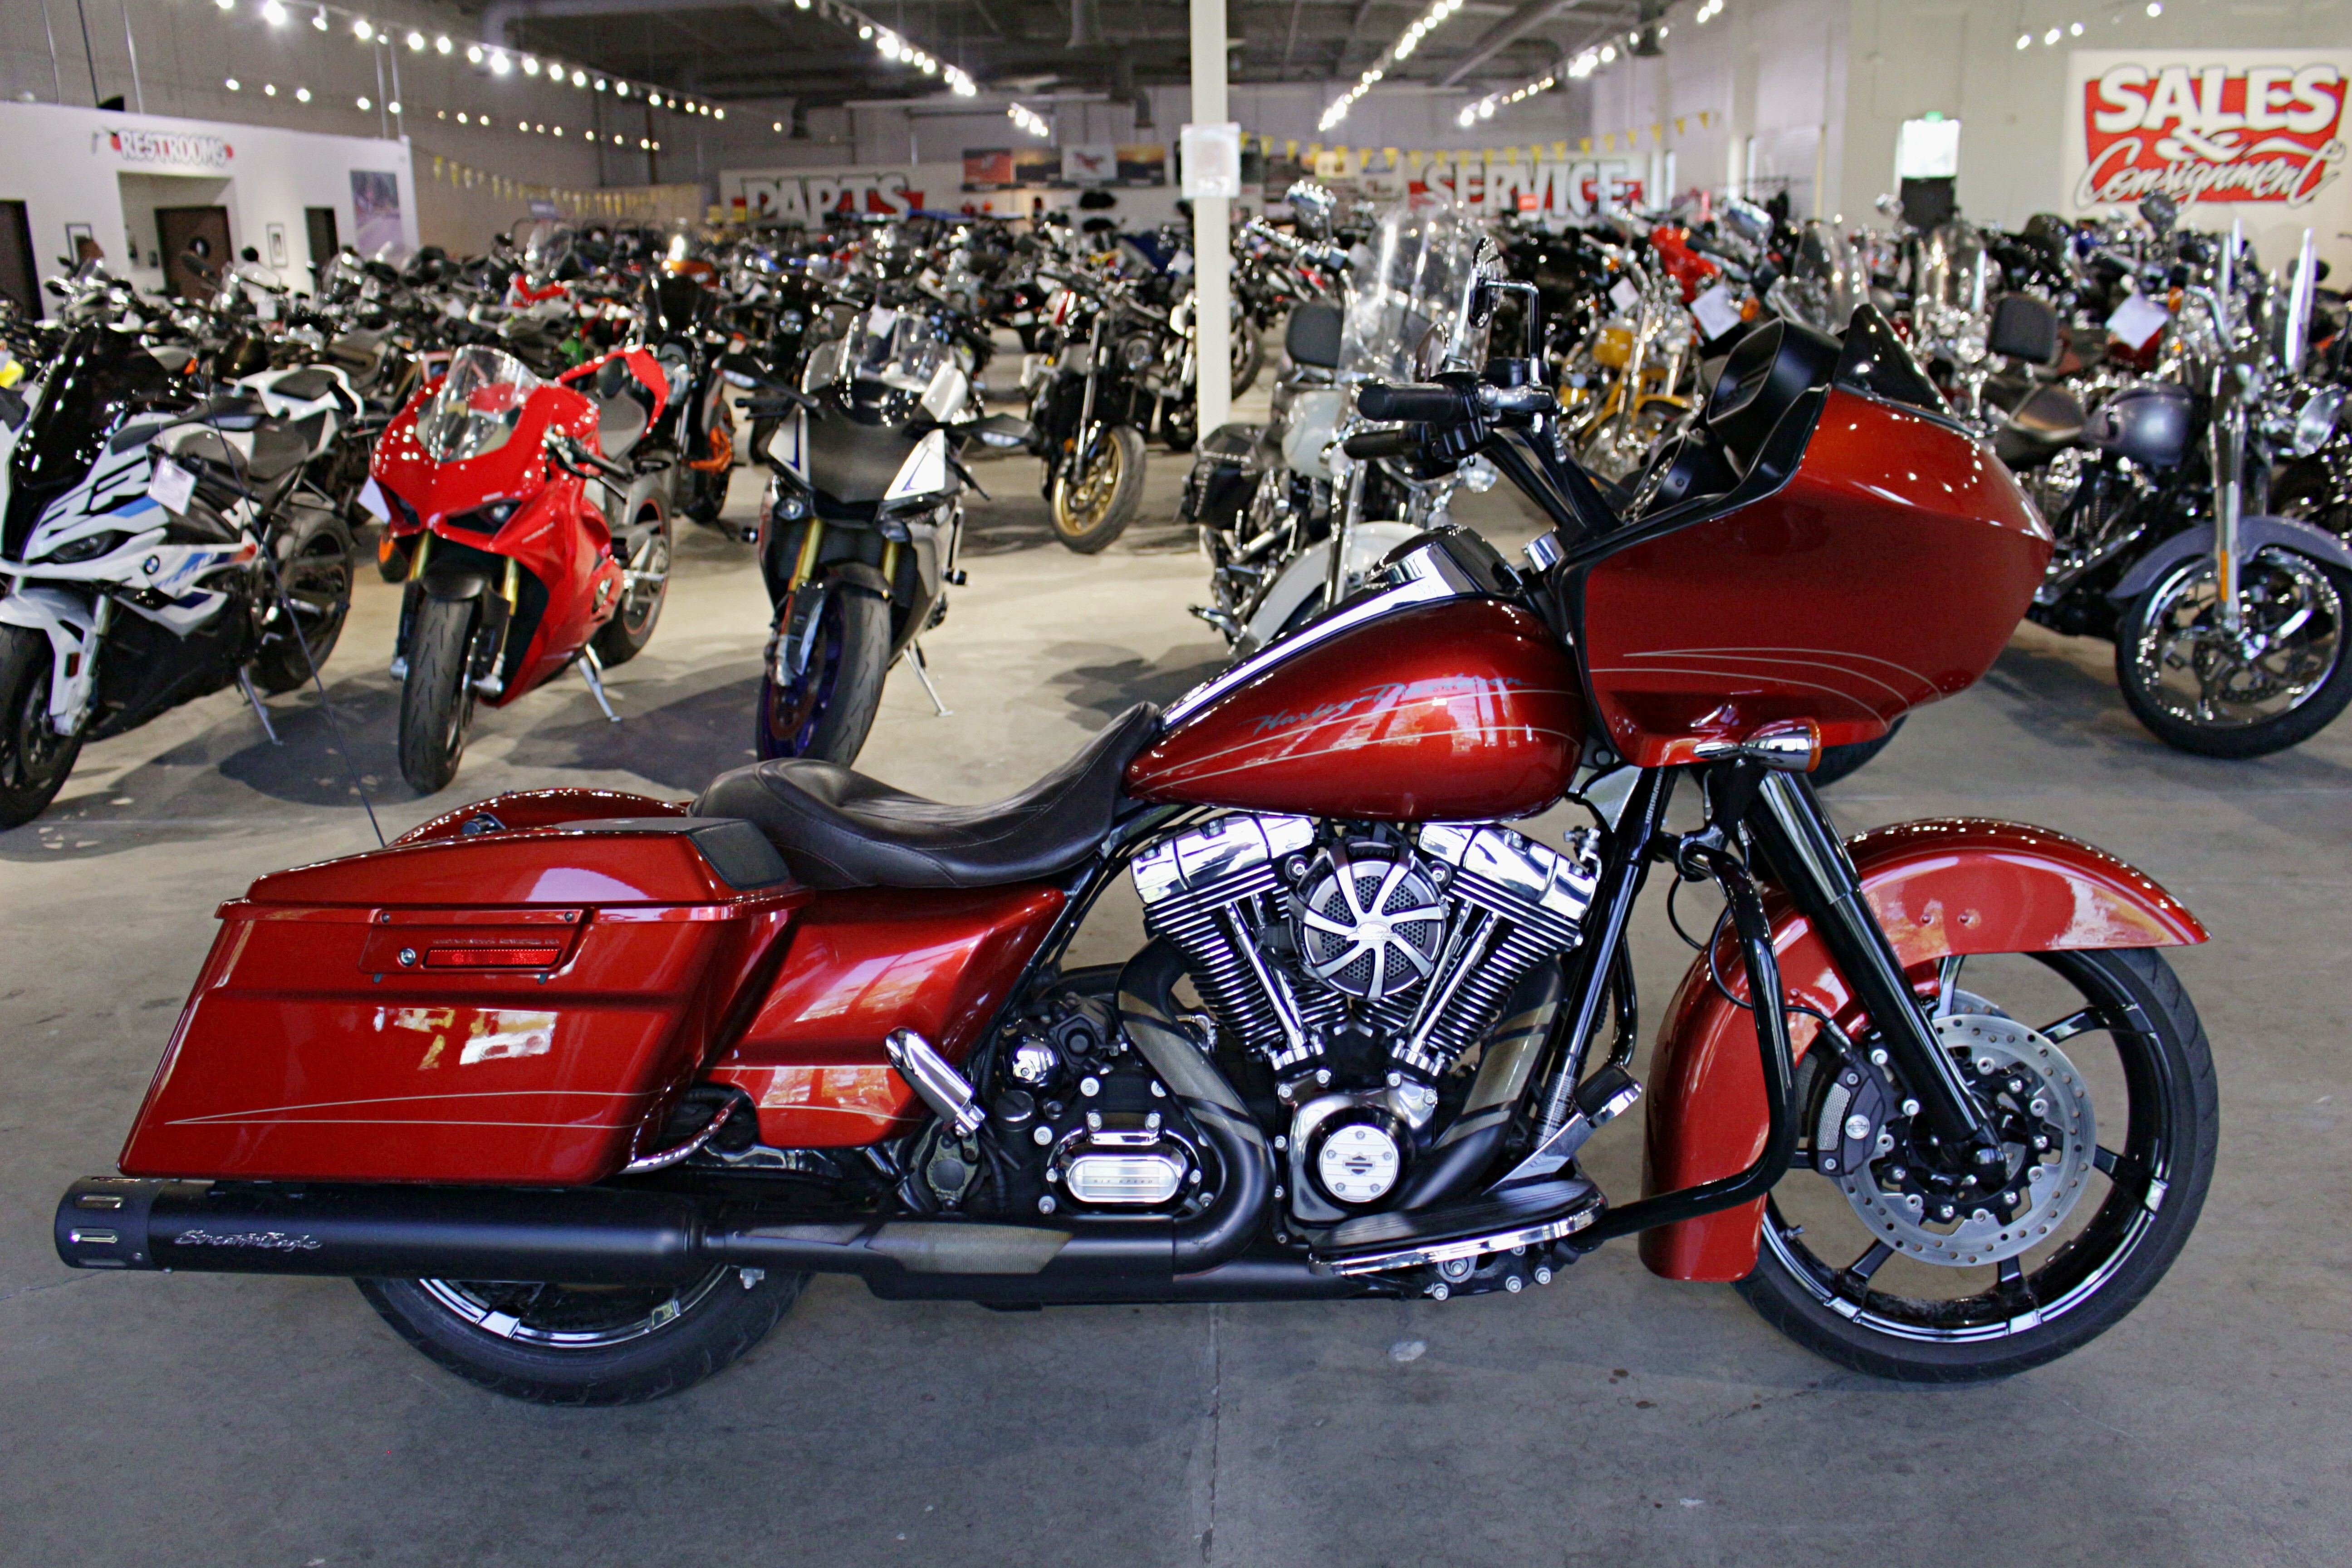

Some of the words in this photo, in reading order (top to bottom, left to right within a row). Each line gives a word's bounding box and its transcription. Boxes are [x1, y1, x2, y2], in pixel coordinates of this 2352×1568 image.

[2092, 63, 2340, 133] SALES
[117, 129, 226, 167] RESTROOMS
[2074, 136, 2347, 215] Consignment
[741, 172, 911, 229] PARTS
[1422, 159, 1630, 220] SERVICE
